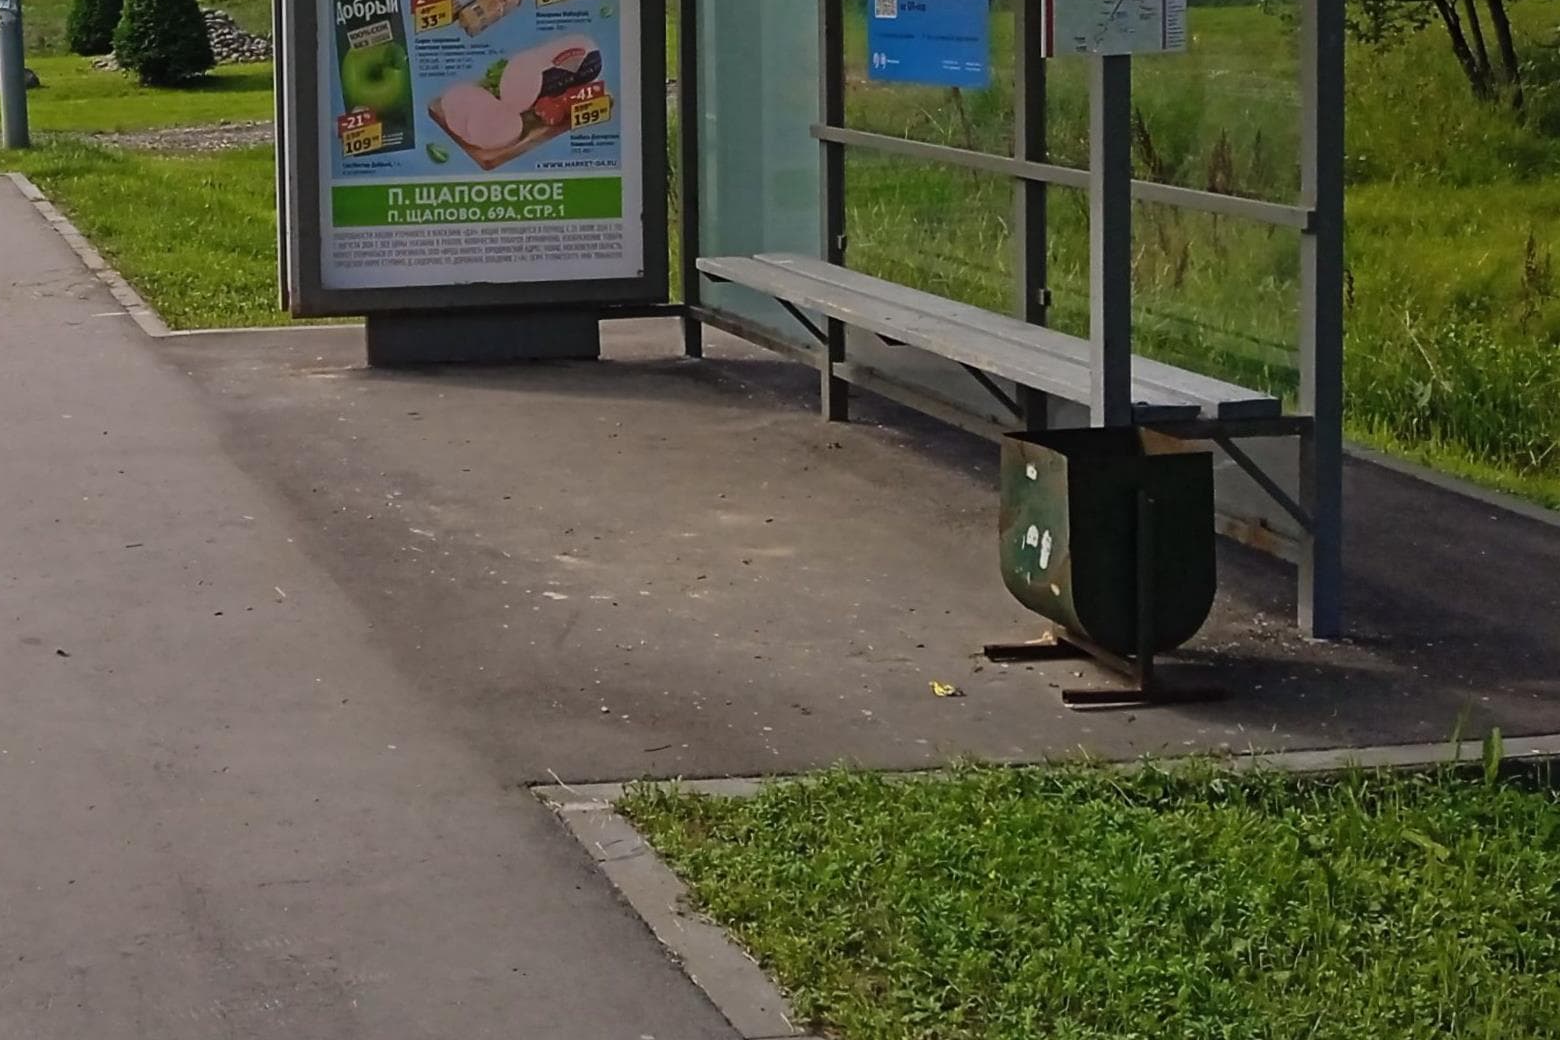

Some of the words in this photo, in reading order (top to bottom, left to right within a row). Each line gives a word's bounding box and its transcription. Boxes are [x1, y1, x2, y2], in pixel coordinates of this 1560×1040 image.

[388, 188, 410, 205] П.
[415, 182, 564, 207] ЩАПОВСКОЕ
[388, 210, 404, 223] П.
[406, 207, 485, 223] ЩАПОВО,
[487, 206, 521, 220] 69А,
[523, 204, 556, 218] СТР.
[558, 203, 565, 217] 1
